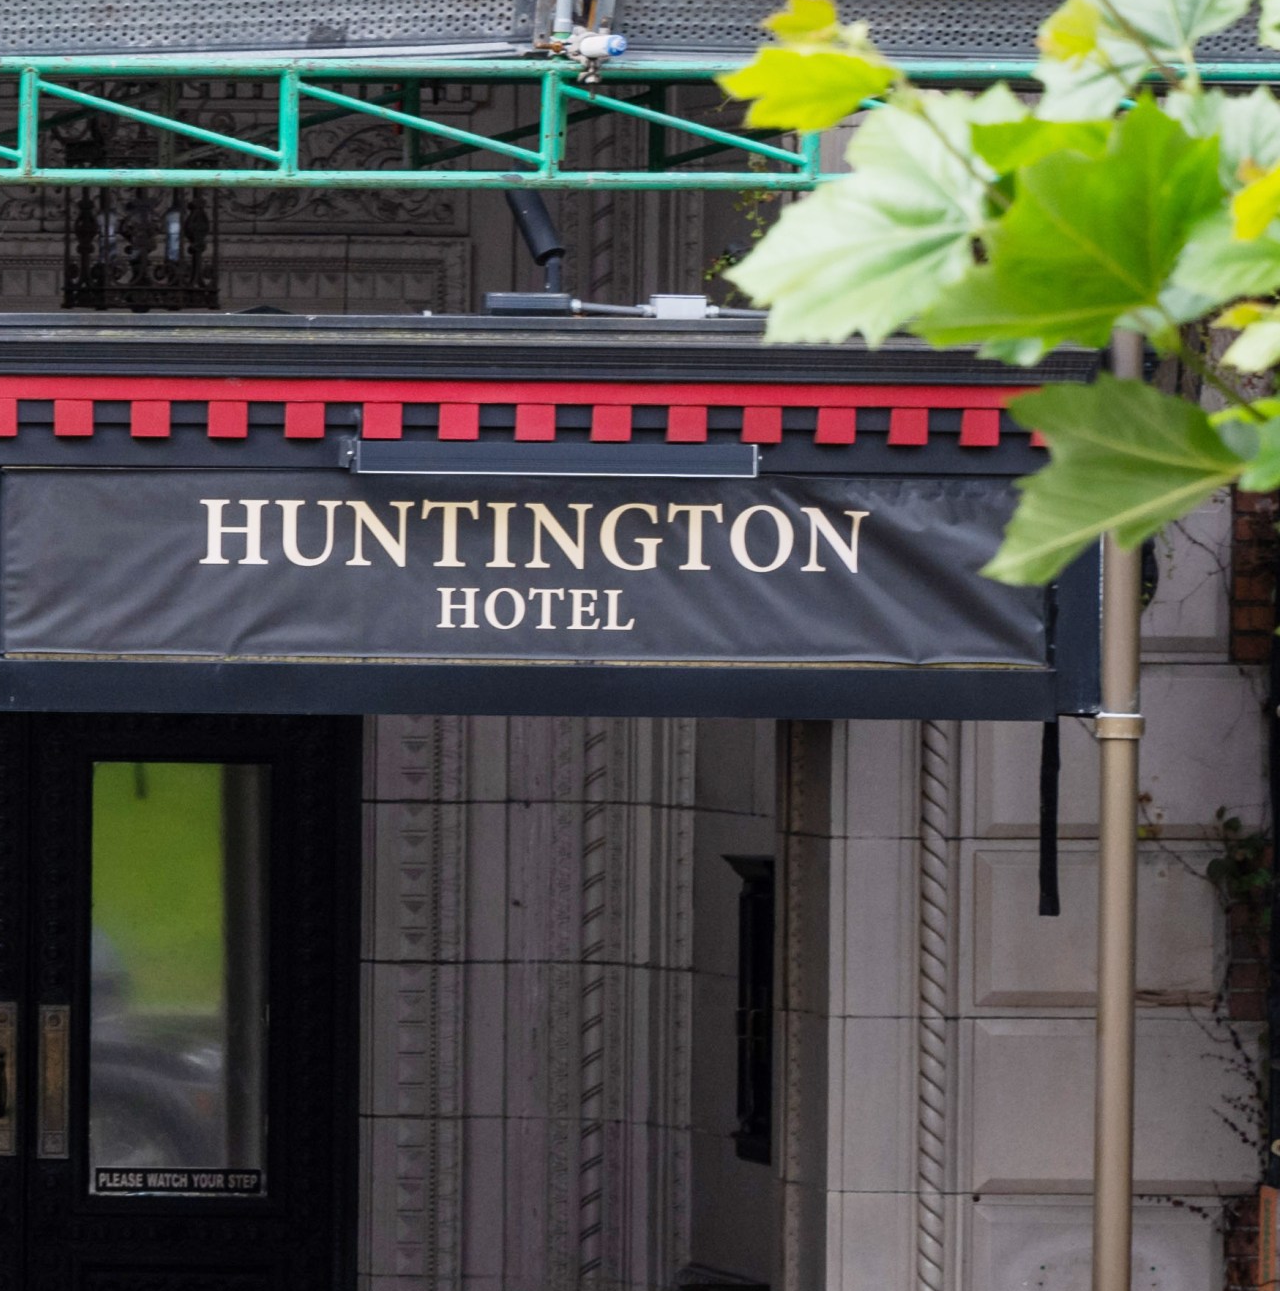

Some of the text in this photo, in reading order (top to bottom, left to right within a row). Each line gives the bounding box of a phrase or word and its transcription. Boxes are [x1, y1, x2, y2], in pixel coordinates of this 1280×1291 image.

[198, 498, 871, 574] HUNTINGTON
[436, 586, 636, 631] HOTEL
[97, 1172, 259, 1189] PLEASE WATCH YOUR STEP
